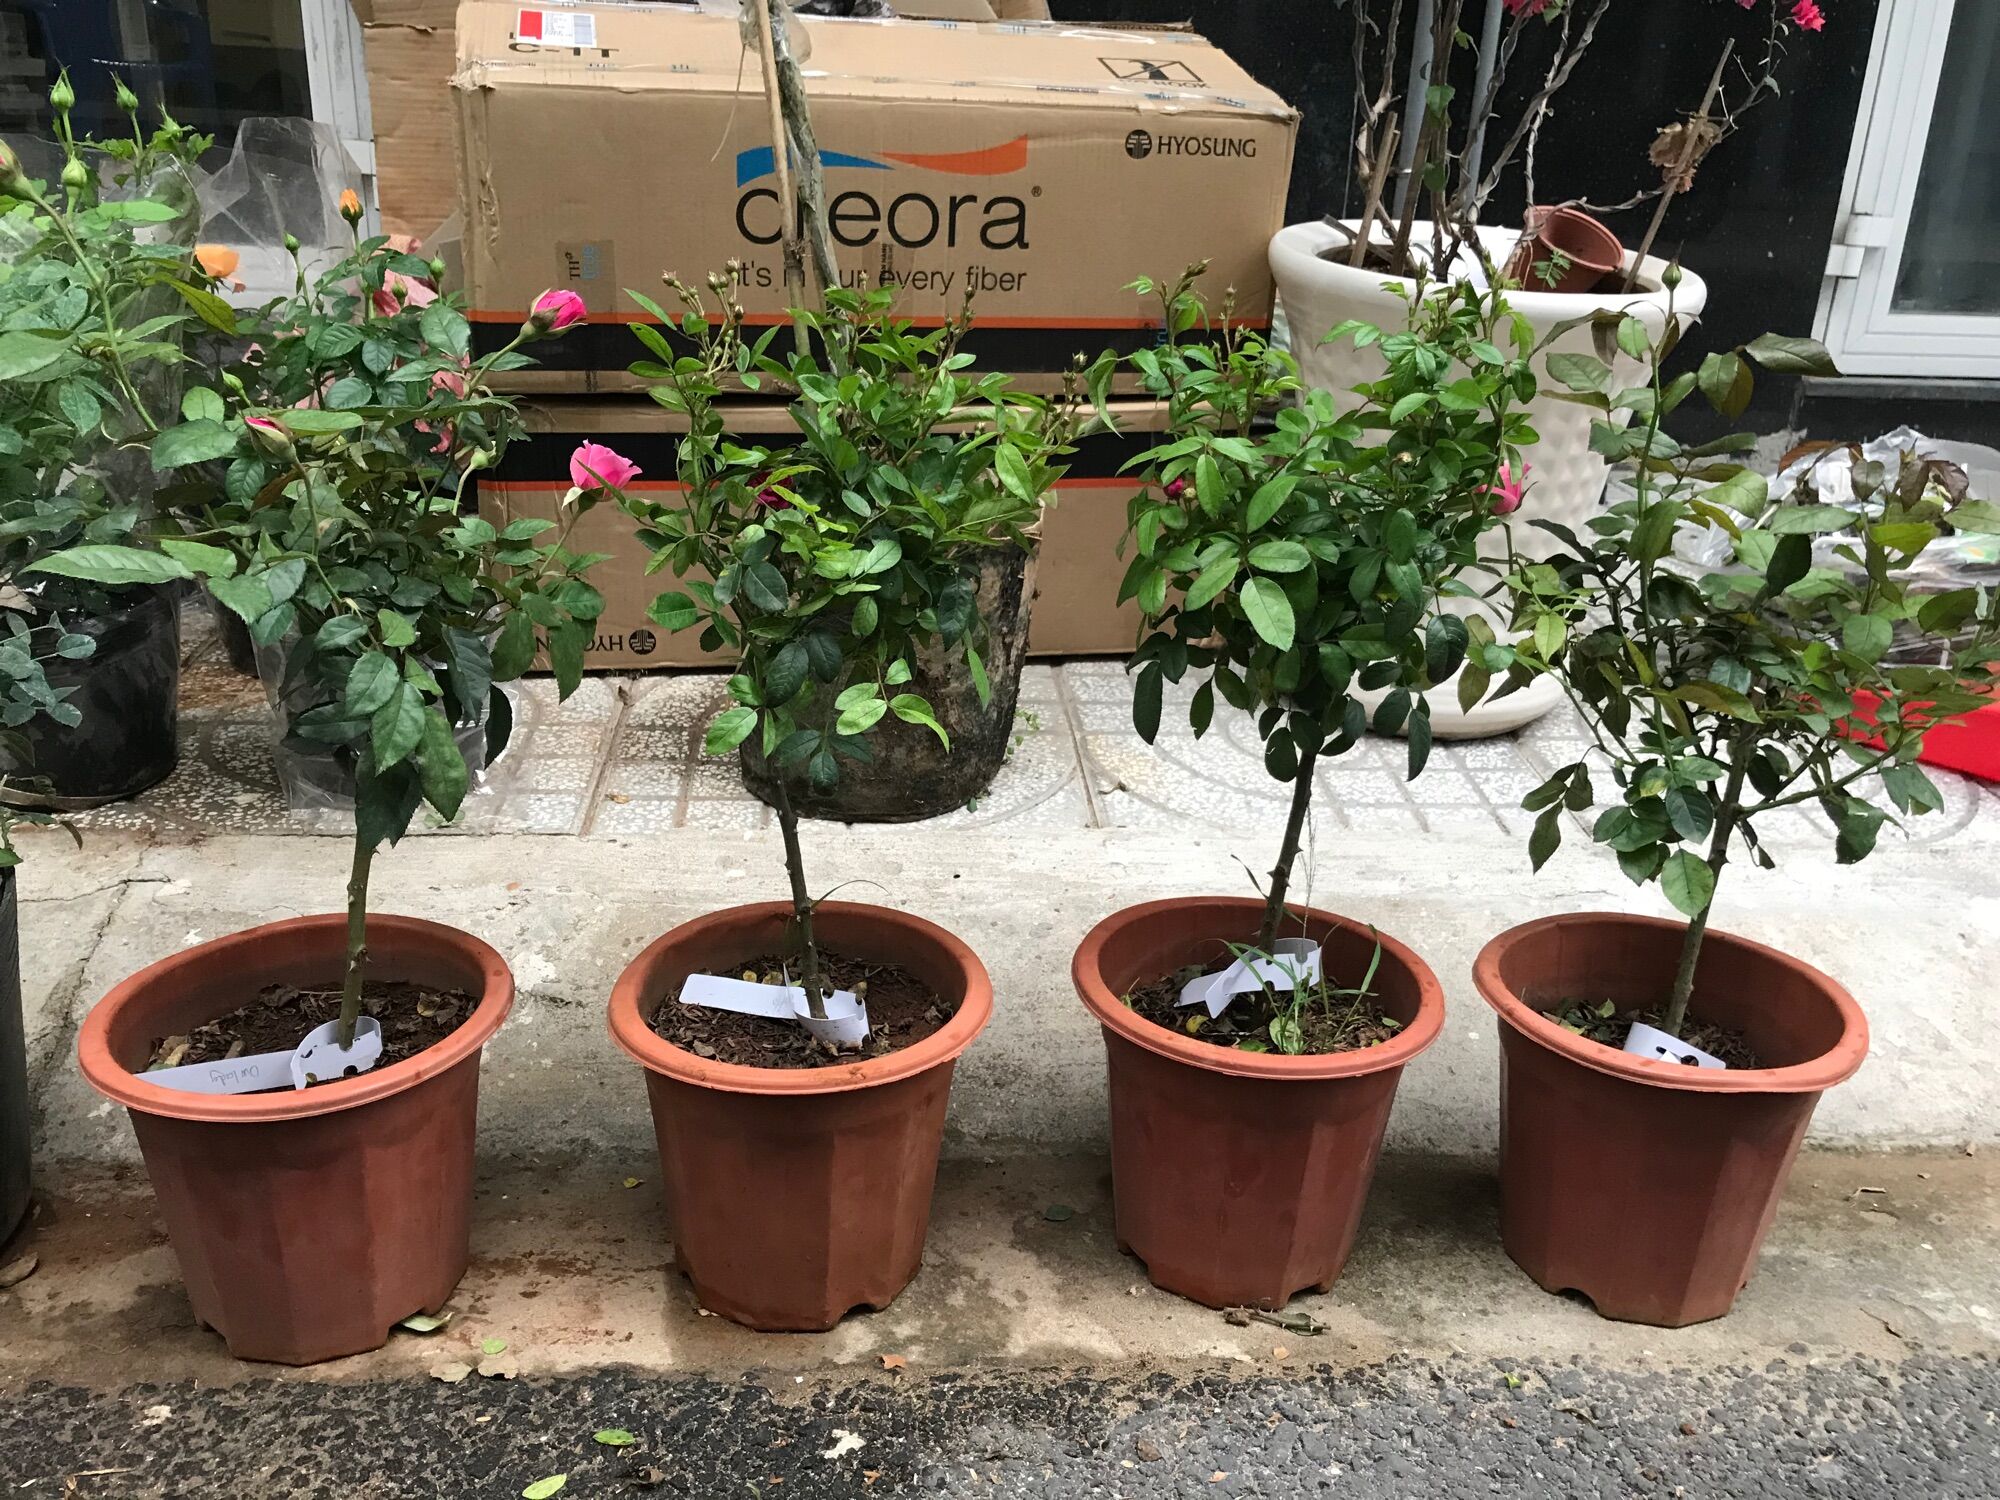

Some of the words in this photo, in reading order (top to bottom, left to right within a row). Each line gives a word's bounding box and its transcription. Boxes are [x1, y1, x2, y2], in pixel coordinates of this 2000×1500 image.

[1157, 135, 1257, 158] HYOSUNG
[737, 260, 772, 288] t's
[878, 269, 955, 297] every
[966, 265, 1028, 292] fiber
